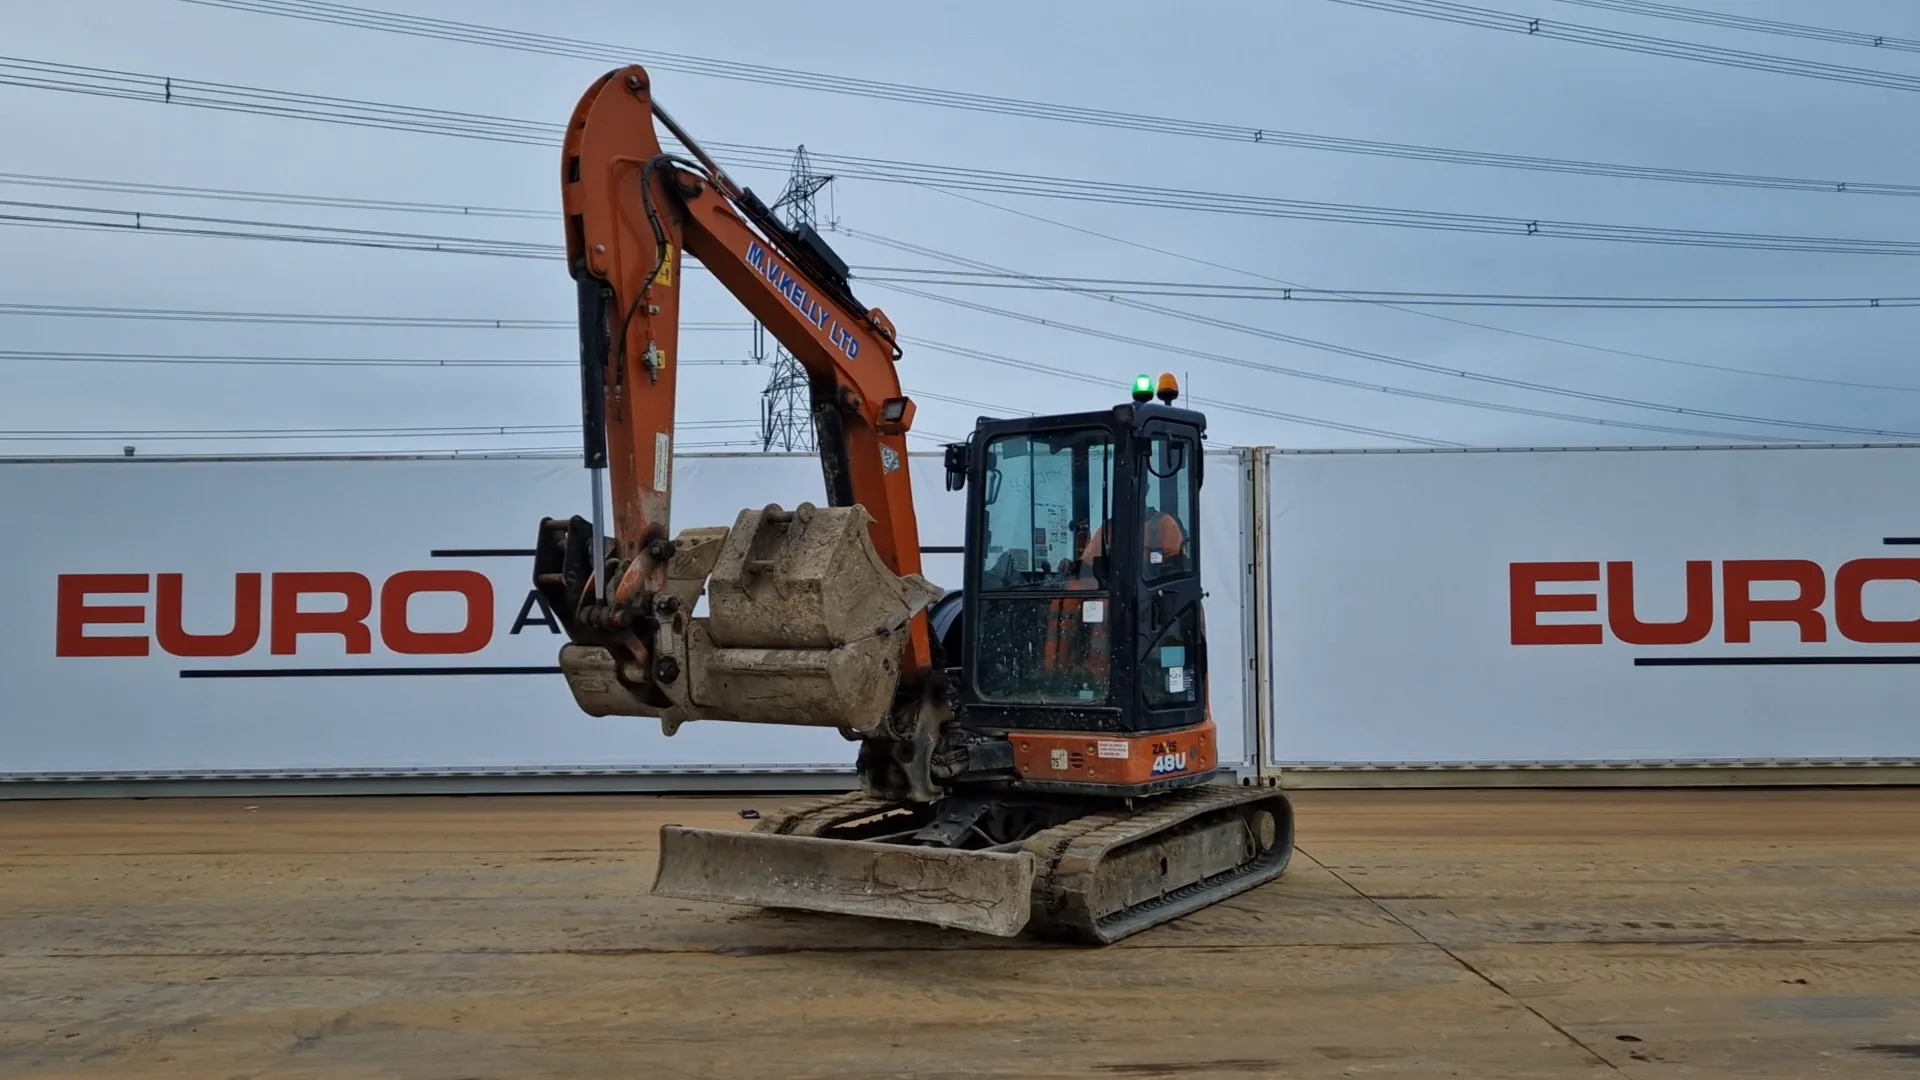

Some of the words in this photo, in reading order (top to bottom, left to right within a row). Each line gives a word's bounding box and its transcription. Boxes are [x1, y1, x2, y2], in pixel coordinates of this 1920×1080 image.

[828, 320, 860, 361] LTD
[57, 570, 494, 657] EURO
[1510, 558, 1920, 645] EURO
[1152, 752, 1187, 773] 48U
